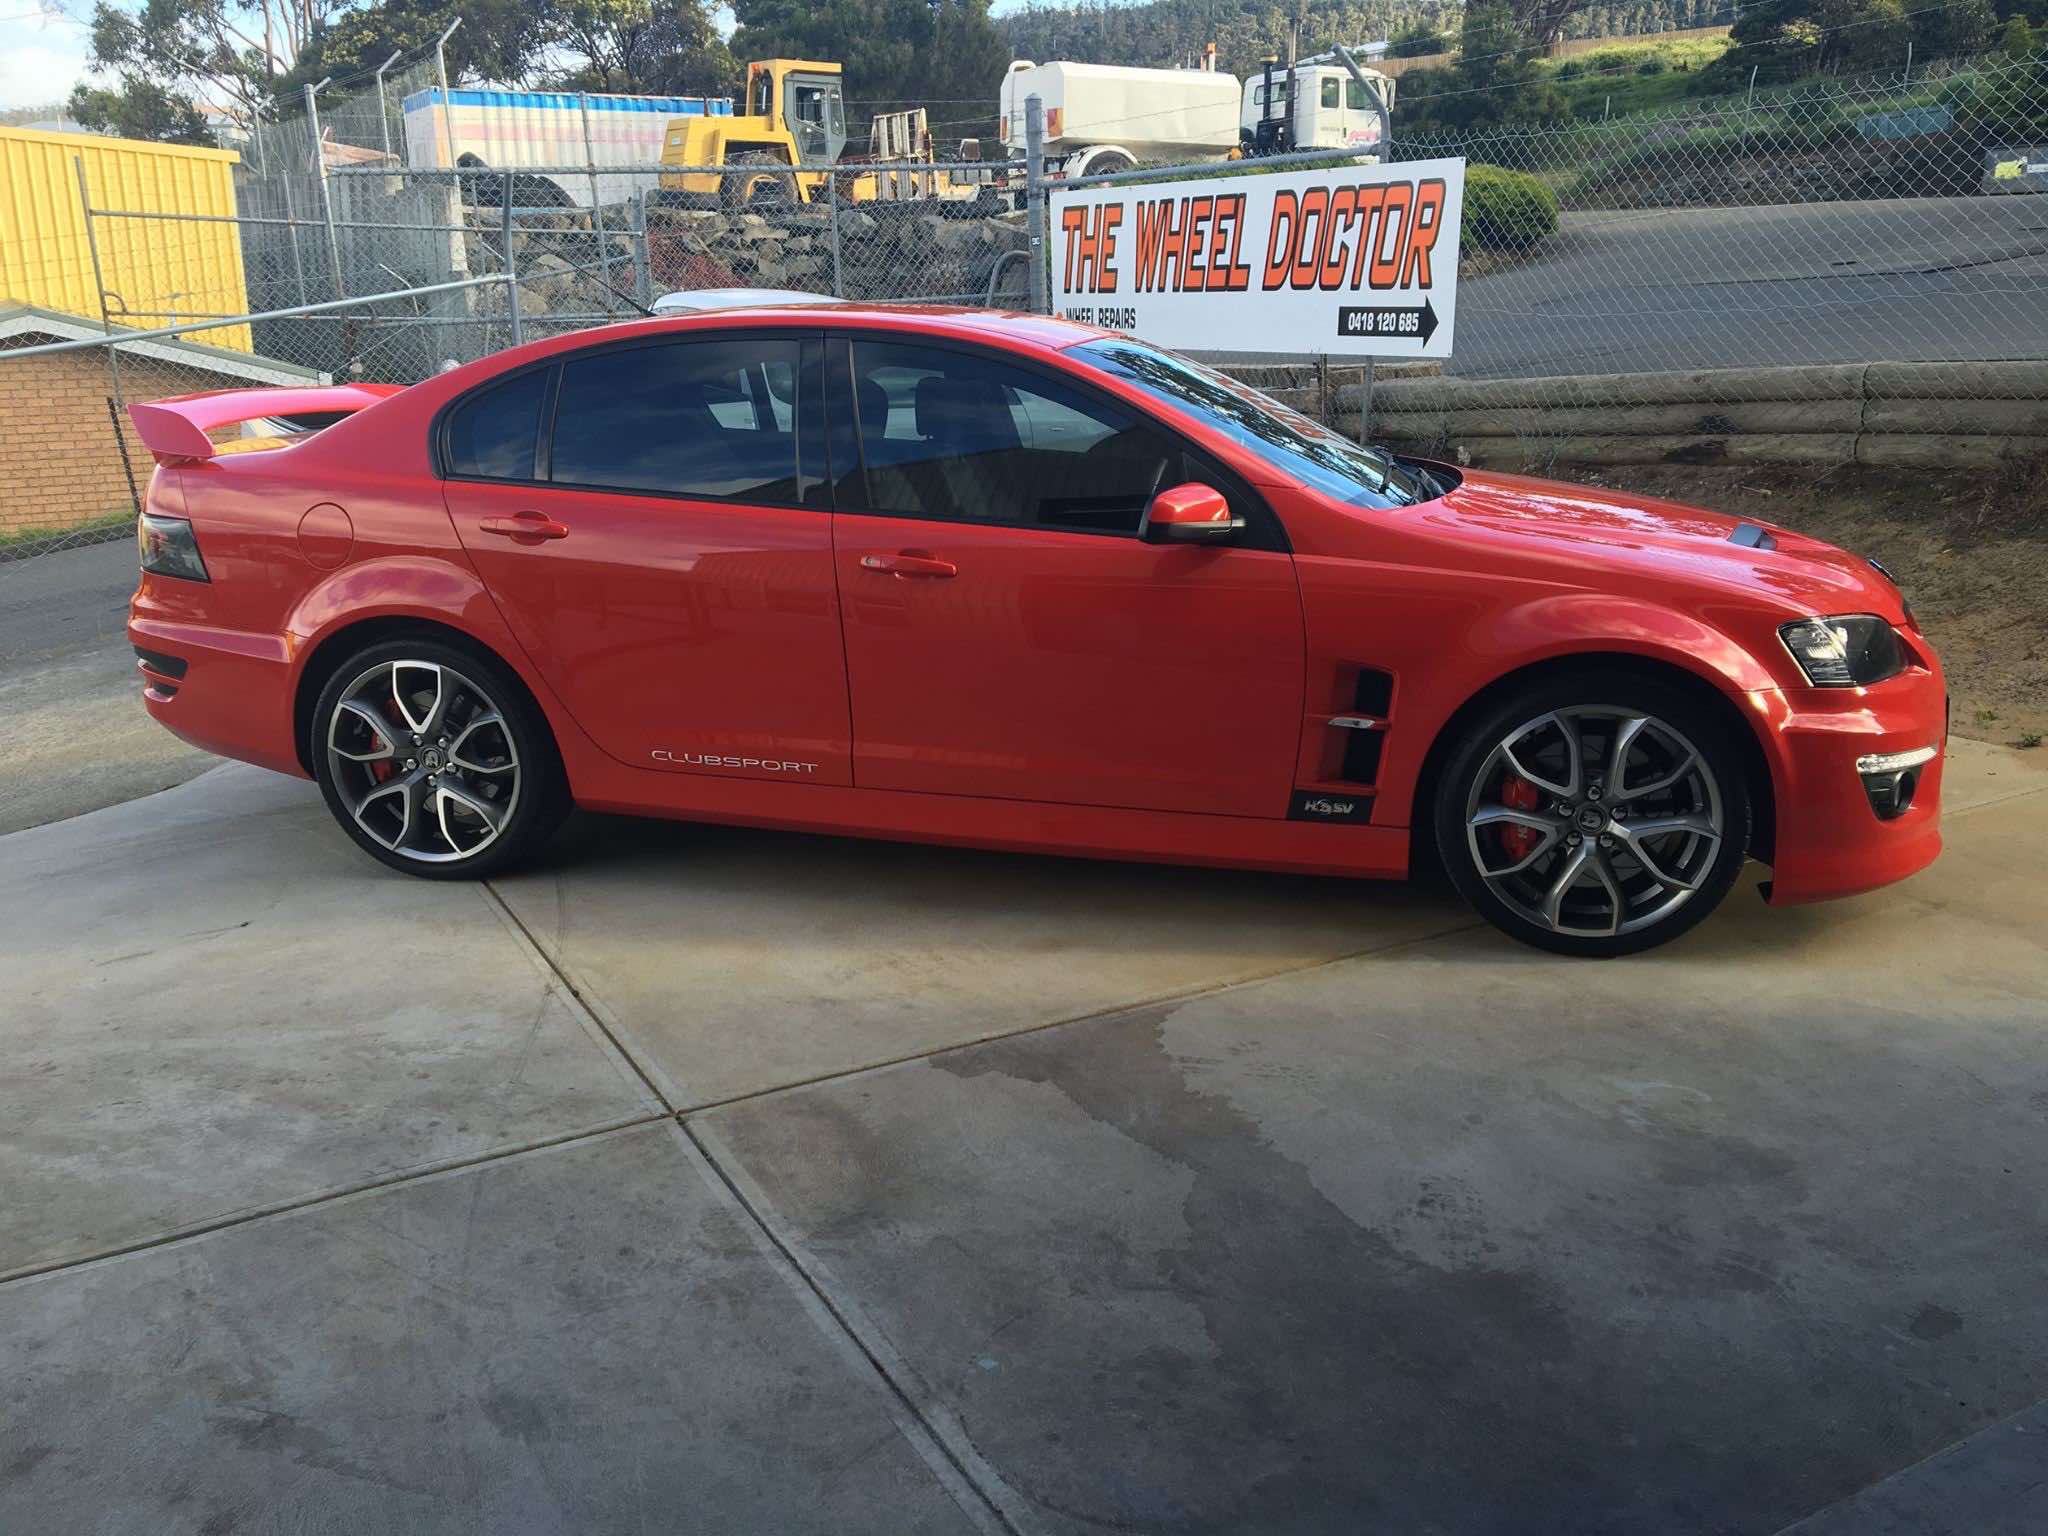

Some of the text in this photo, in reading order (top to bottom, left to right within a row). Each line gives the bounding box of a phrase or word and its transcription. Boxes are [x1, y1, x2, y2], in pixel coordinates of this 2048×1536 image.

[1062, 178, 1447, 294] THE WHEEL DOCTOR
[1098, 307, 1136, 329] REPAIRS
[1348, 312, 1420, 332] 0418 120 685
[651, 750, 818, 773] CLUBSPORT
